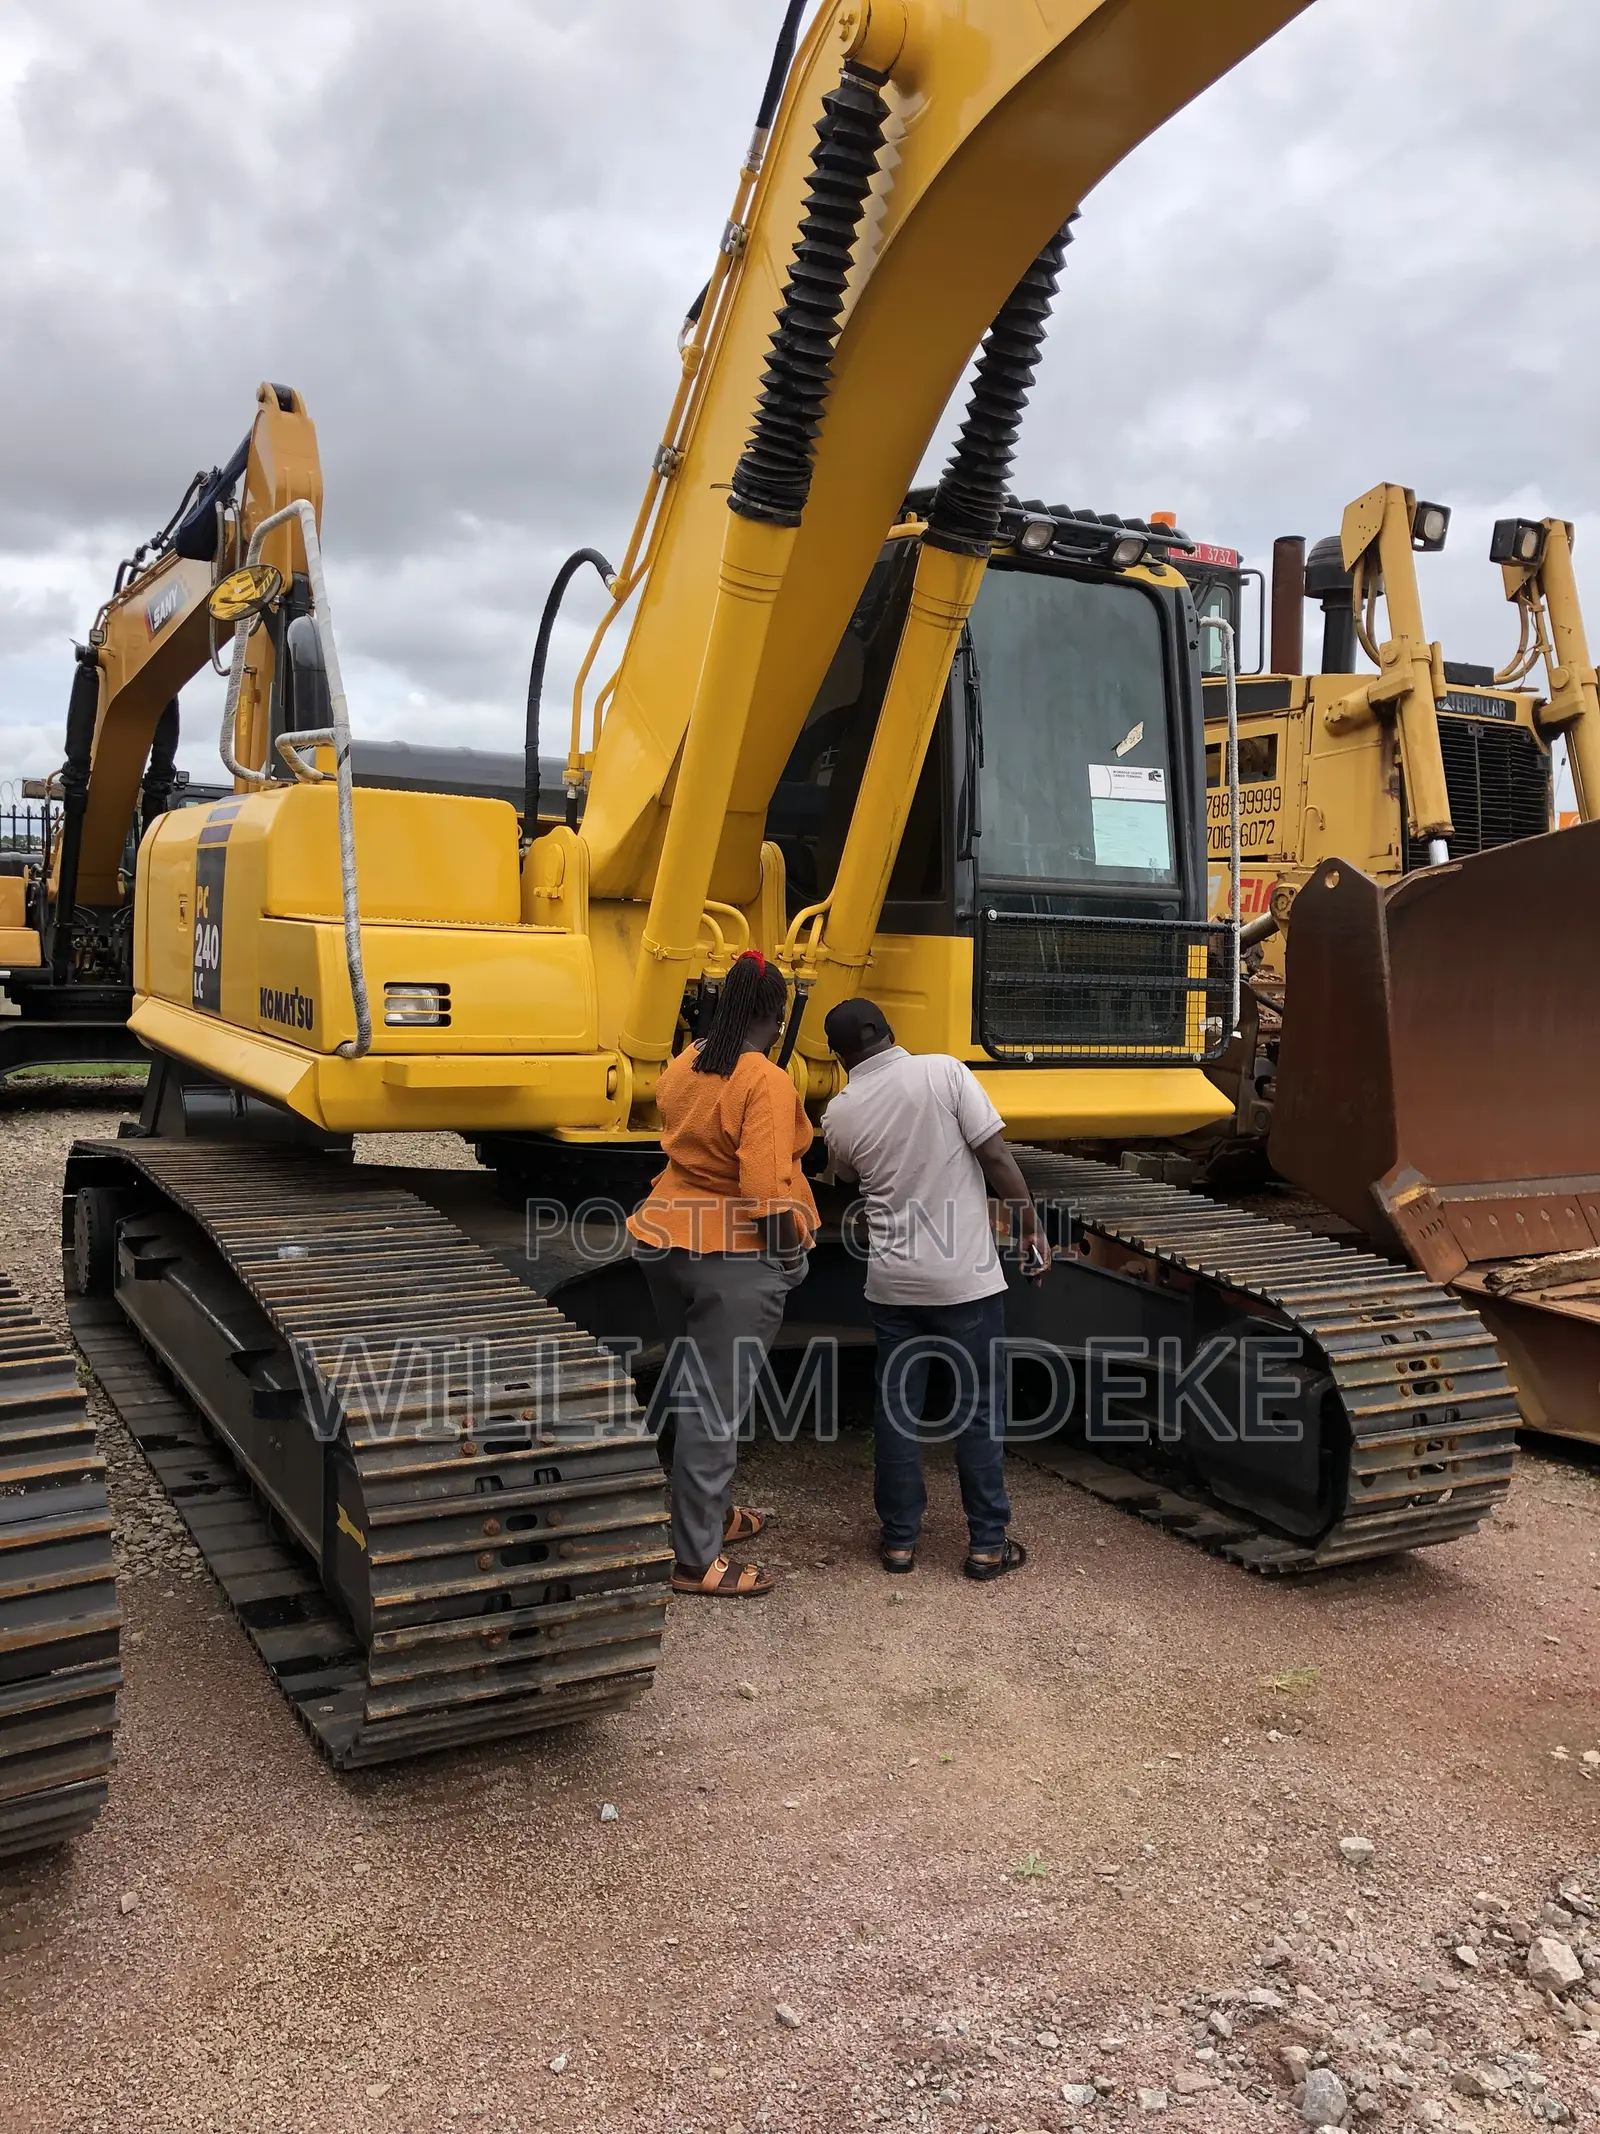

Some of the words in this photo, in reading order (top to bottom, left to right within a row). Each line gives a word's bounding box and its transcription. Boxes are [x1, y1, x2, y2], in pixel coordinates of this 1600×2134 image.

[1207, 547, 1232, 565] 373Z
[153, 584, 178, 630] SANY
[1437, 694, 1507, 718] CATERPILLAR
[1207, 786, 1282, 819] 78899999
[1207, 819, 1276, 850] 70166072
[197, 885, 210, 919] PC
[194, 923, 220, 970] 240
[193, 971, 204, 999] LC
[260, 986, 315, 1031] KOMATSU
